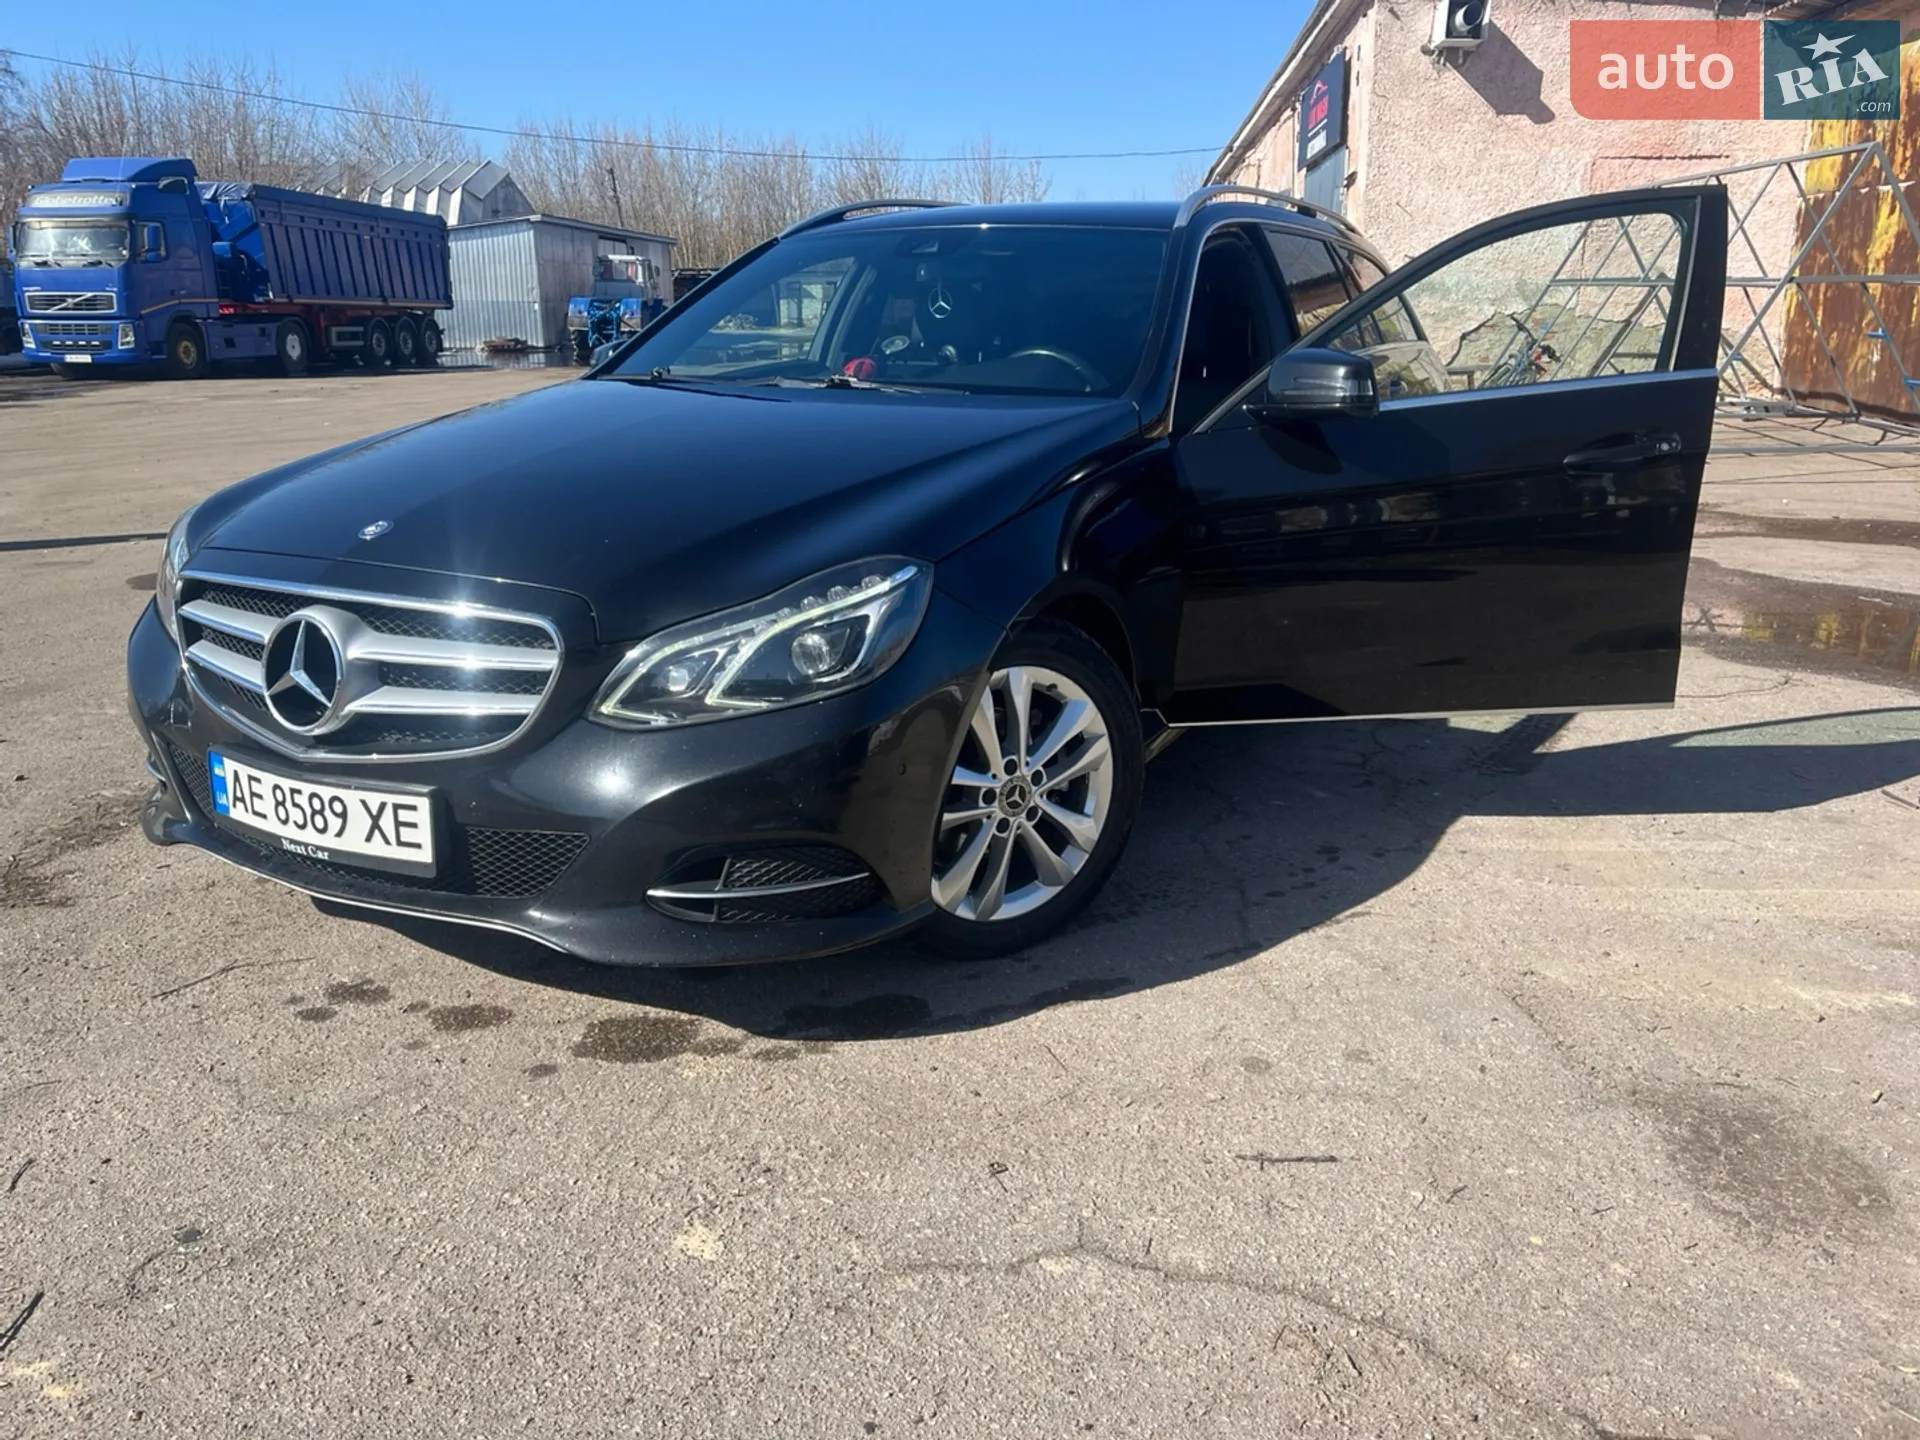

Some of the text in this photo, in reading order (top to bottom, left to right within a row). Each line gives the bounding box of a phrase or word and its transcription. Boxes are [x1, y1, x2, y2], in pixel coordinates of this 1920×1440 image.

[232, 769, 422, 849] AE 8589 XE
[281, 838, 329, 860] Next Car
